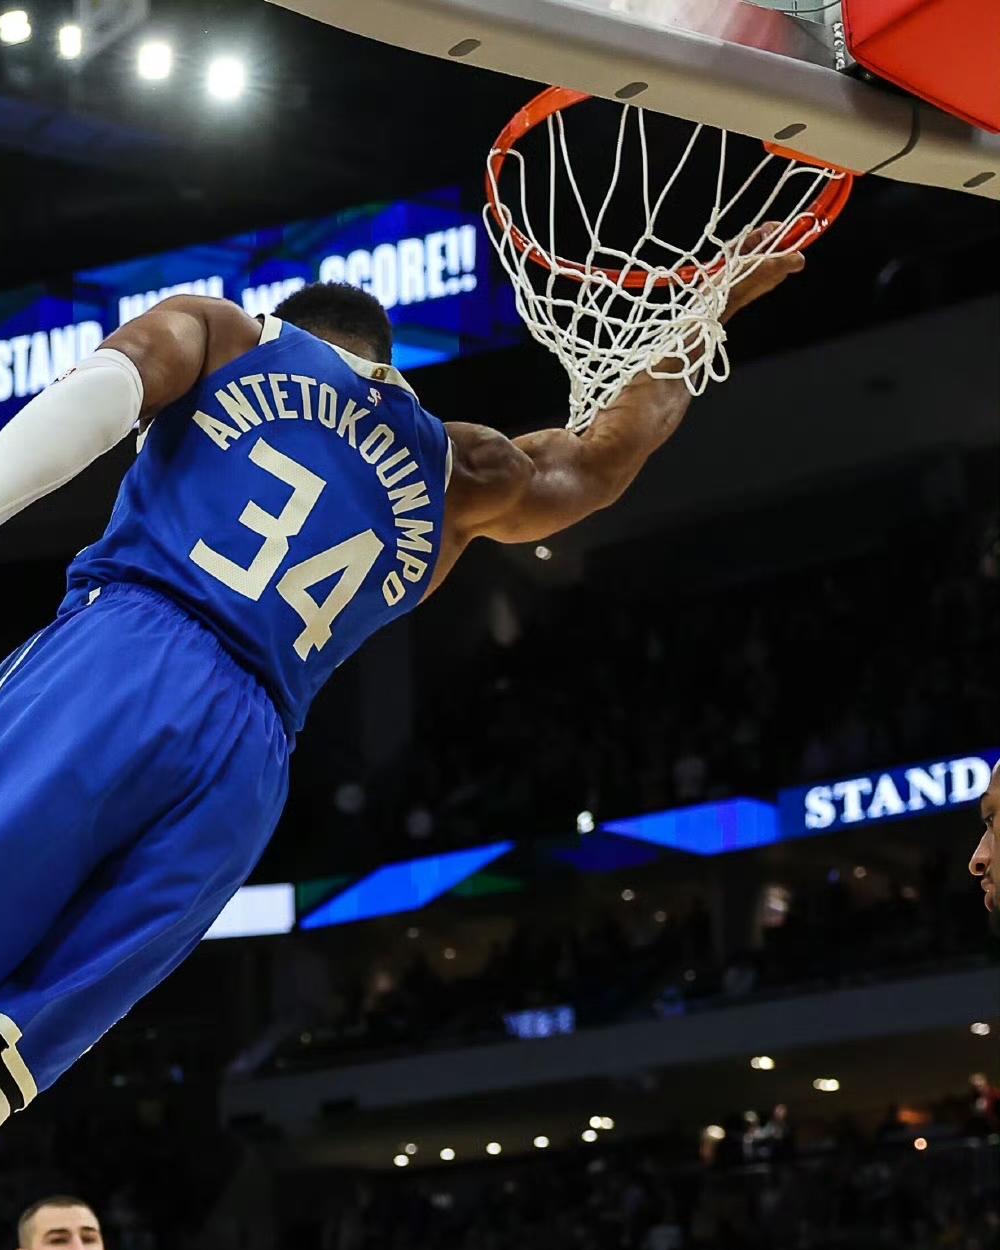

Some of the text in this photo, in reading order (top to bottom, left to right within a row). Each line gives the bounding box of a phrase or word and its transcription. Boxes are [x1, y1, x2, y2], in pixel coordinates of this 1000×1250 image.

[189, 437, 385, 662] 34
[192, 373, 434, 607] ANTETOKOUNMPO
[804, 756, 992, 830] STAND
